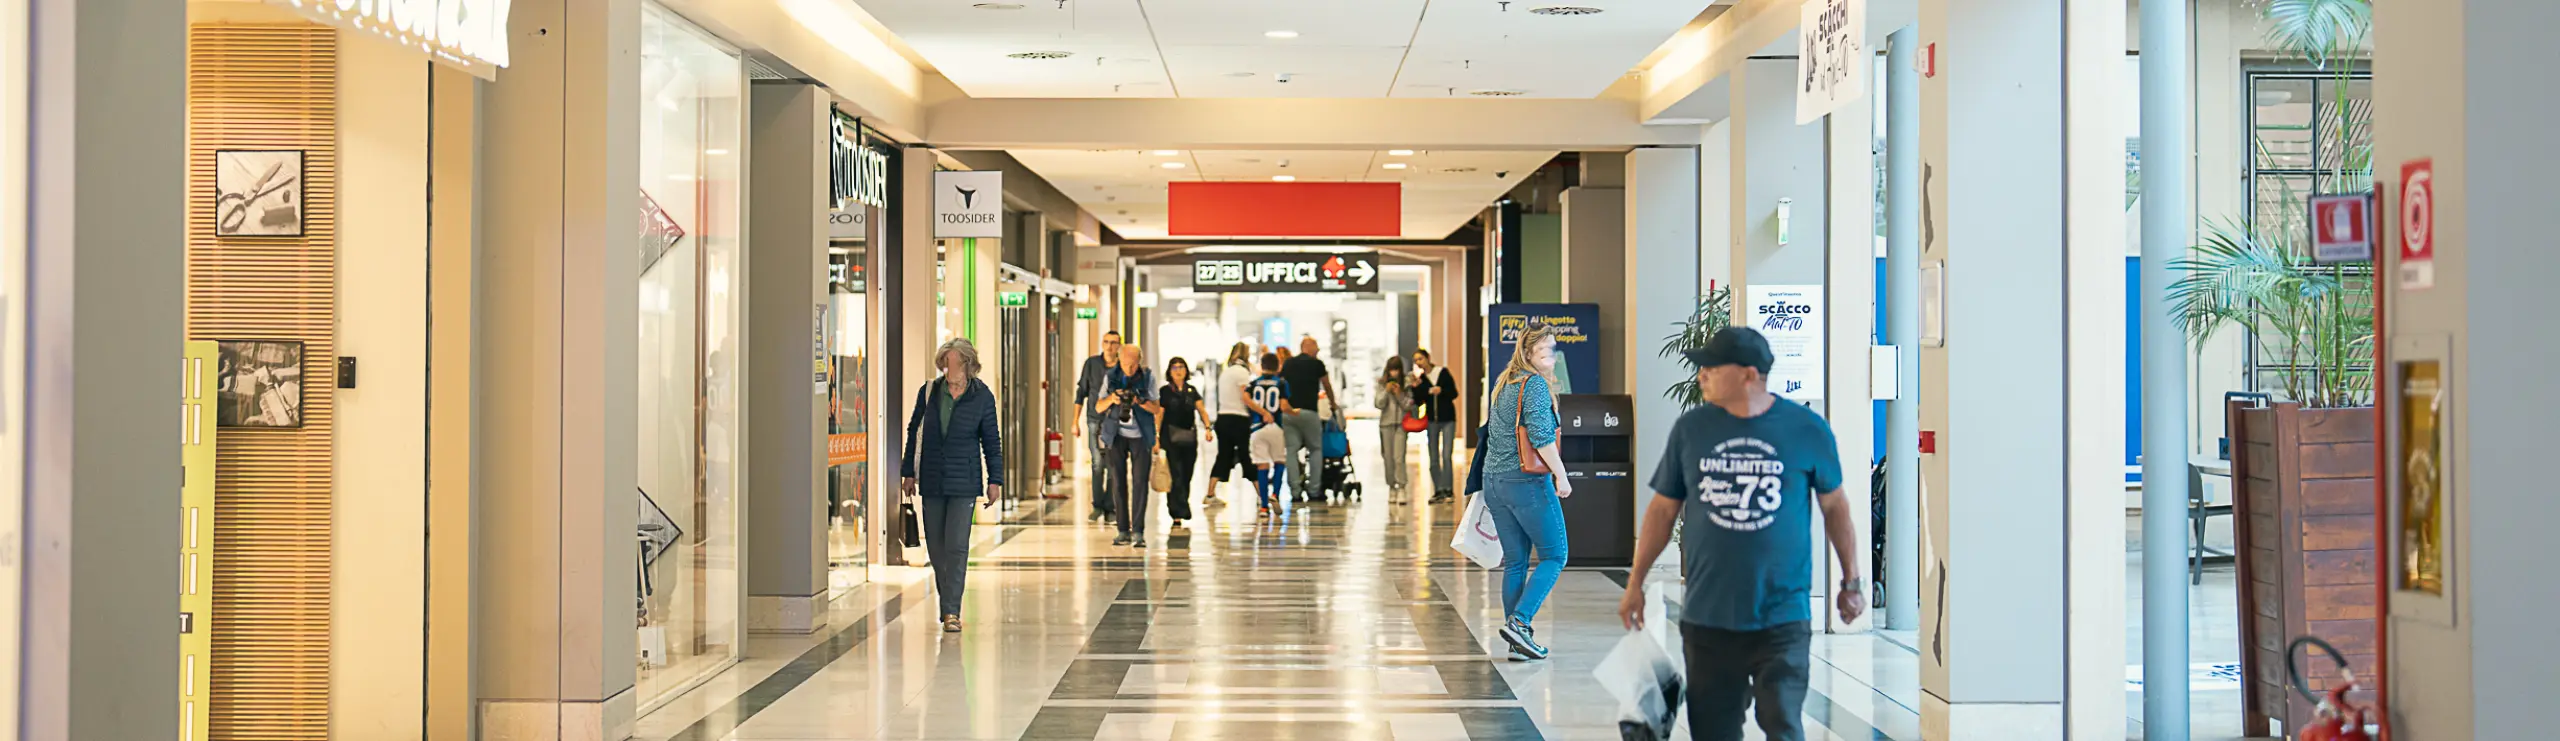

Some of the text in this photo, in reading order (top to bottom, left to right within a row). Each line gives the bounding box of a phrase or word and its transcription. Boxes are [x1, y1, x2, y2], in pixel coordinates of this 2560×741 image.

[941, 213, 996, 224] TOOSIDER
[1246, 262, 1317, 283] UFFICI
[1759, 304, 1811, 314] SCACCO
[1540, 315, 1576, 326] Lingotto
[1502, 329, 1520, 340] Fift
[1253, 385, 1280, 413] 90
[1699, 457, 1784, 475] UNLIMITED
[1736, 475, 1782, 511] 73
